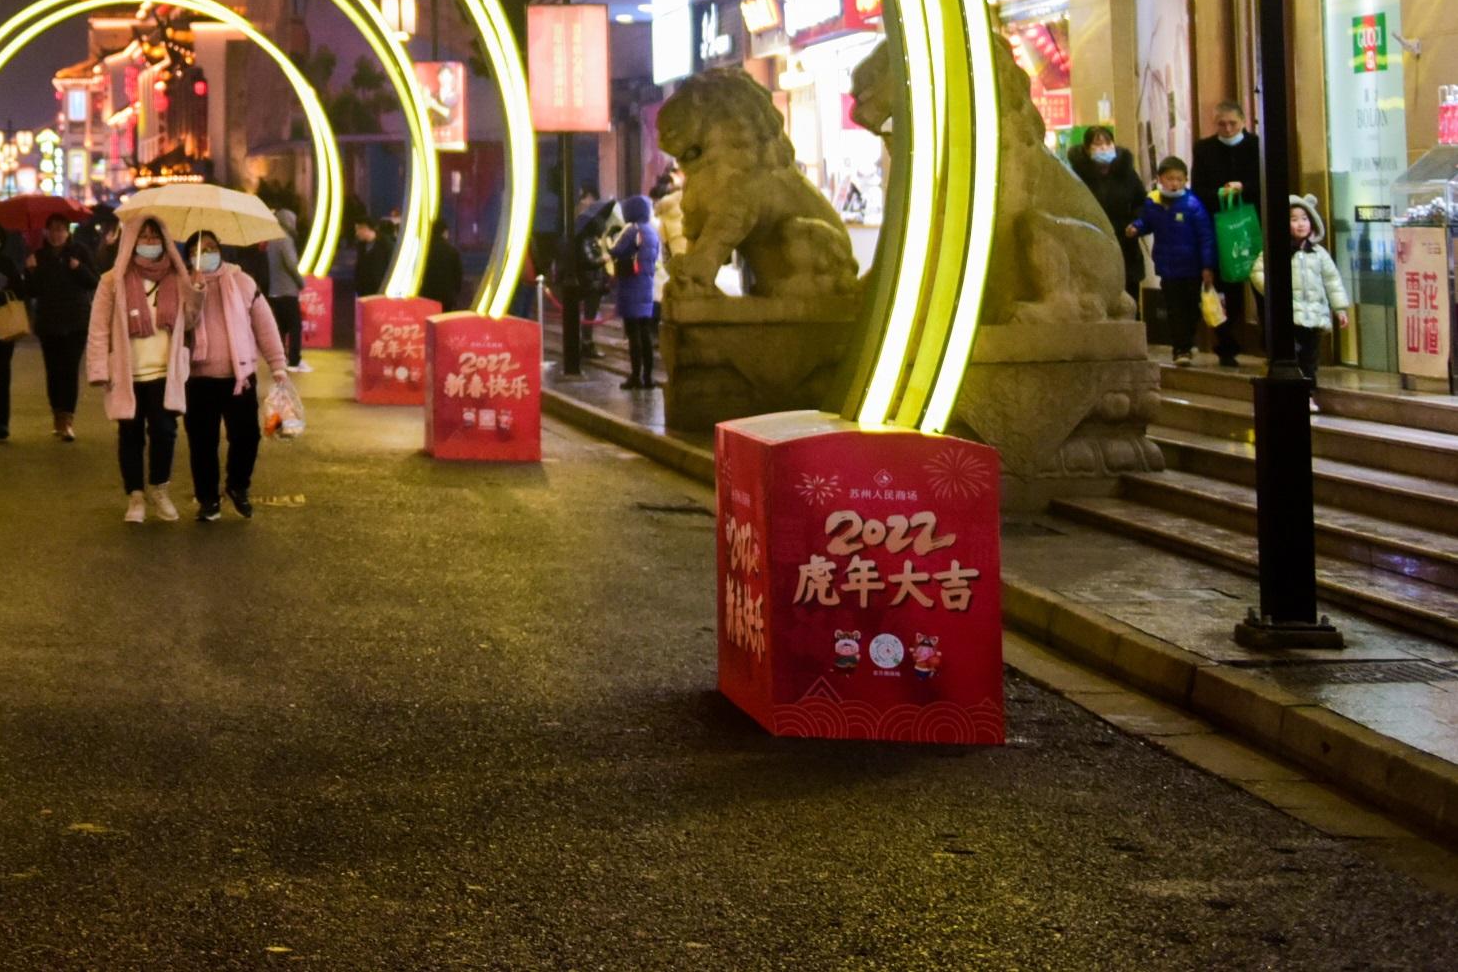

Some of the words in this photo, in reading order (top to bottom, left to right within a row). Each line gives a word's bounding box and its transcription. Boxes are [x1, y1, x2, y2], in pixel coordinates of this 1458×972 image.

[459, 352, 520, 373] 2022
[444, 372, 531, 399] 新春快乐
[849, 489, 918, 502] 苏州人民商场
[825, 510, 956, 556] 2022
[793, 554, 980, 612] 虎年大吉
